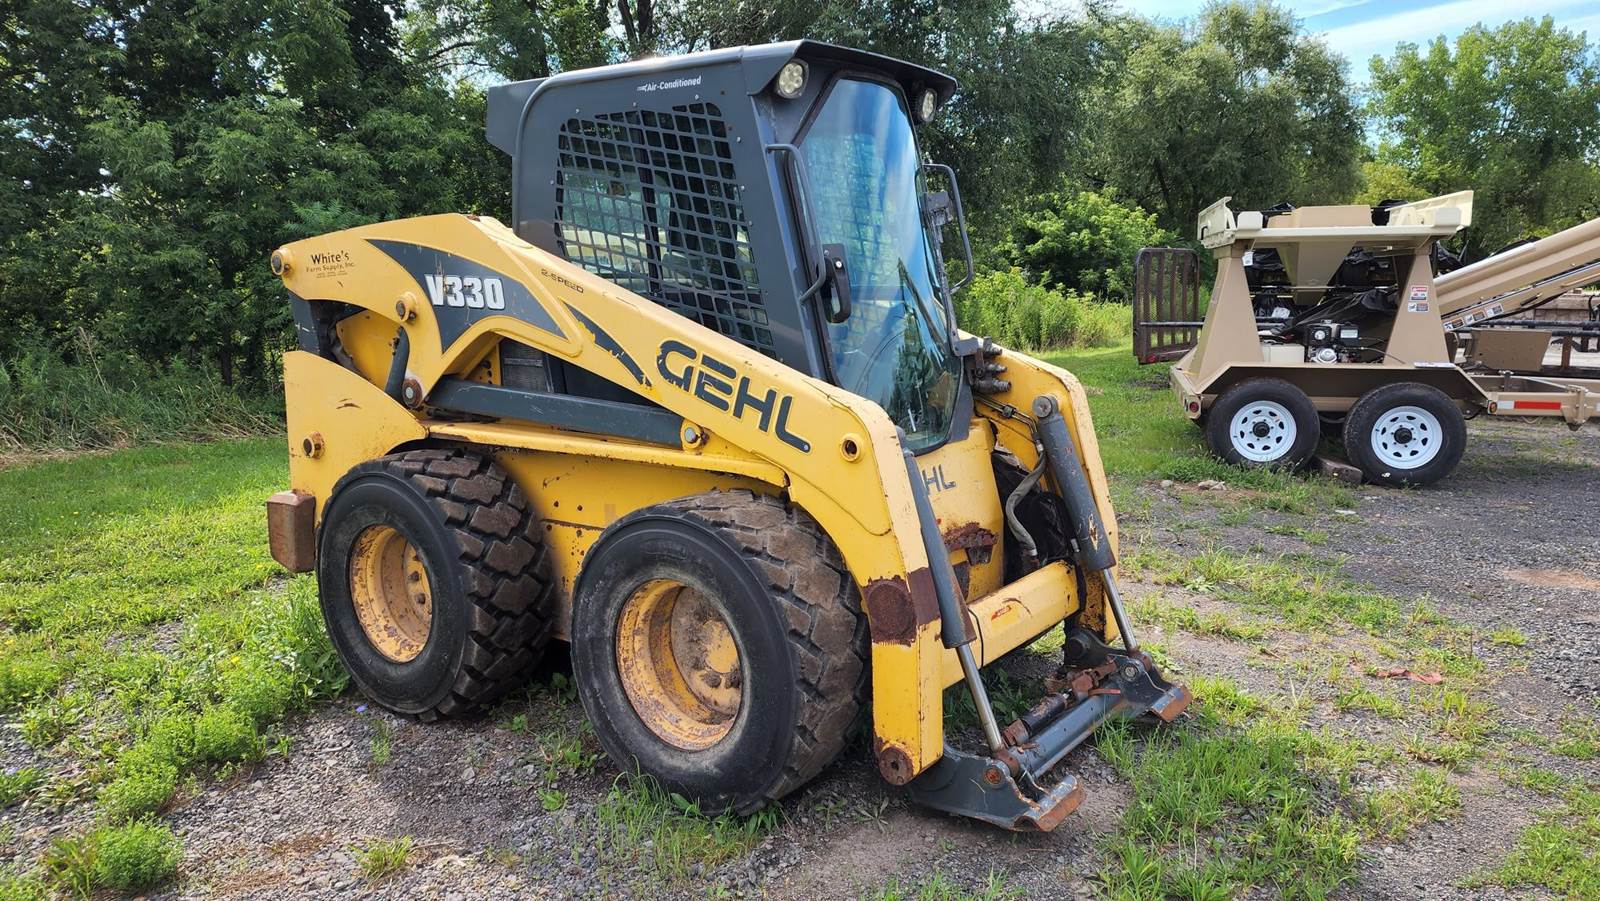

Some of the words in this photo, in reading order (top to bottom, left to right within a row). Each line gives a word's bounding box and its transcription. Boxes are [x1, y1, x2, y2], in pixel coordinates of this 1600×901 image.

[646, 75, 701, 91] Air-Conditioned
[310, 250, 349, 264] White's
[424, 274, 505, 310] V330
[540, 268, 584, 294] 2-SPEED
[656, 340, 811, 453] GEHL
[922, 463, 957, 495] HL
